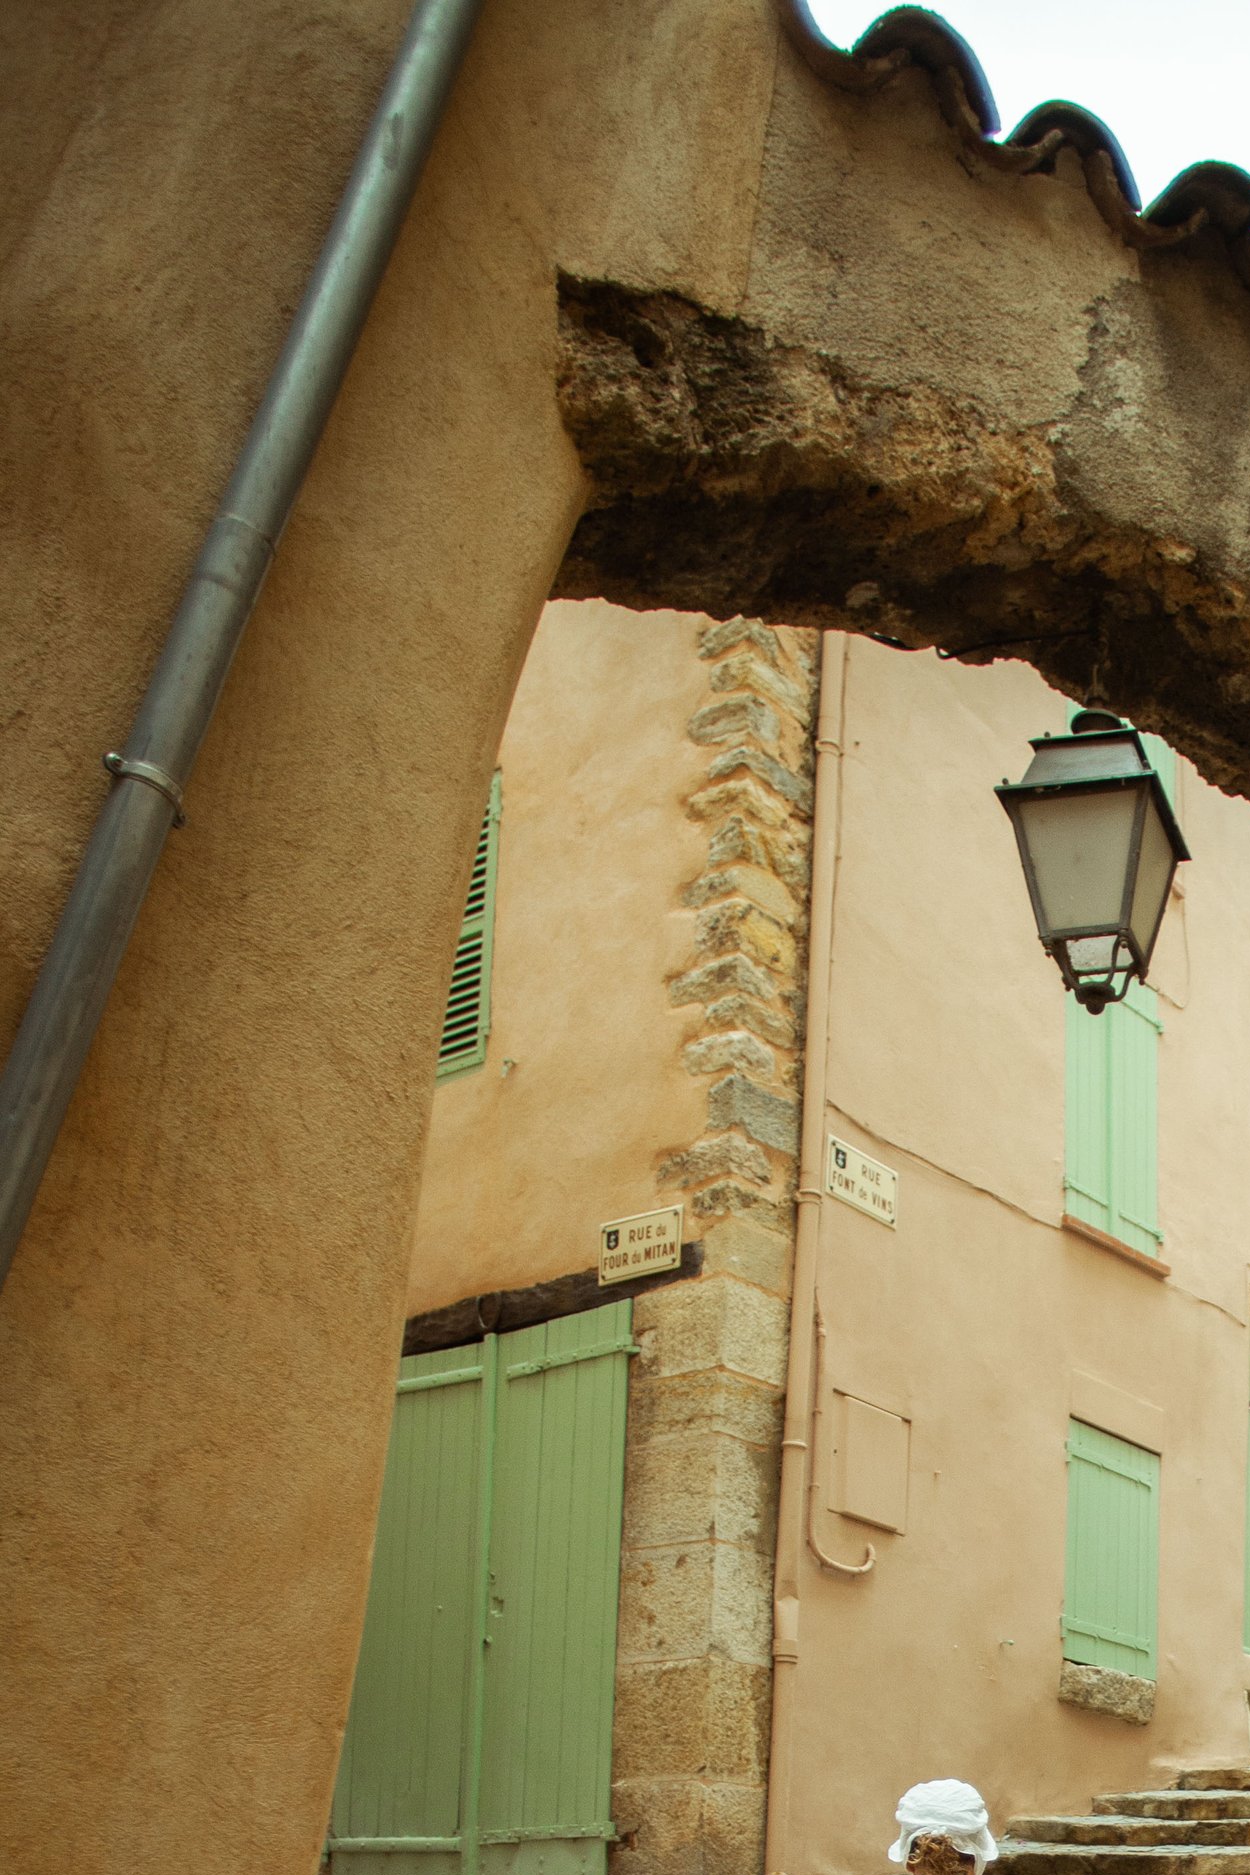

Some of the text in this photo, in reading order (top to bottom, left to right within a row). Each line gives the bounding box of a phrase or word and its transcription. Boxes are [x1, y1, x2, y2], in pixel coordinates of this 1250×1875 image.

[861, 1164, 881, 1186] RUE
[832, 1171, 893, 1214] FONT de VINS
[629, 1223, 667, 1243] RUE du
[603, 1241, 676, 1271] FOUR du MITAN
